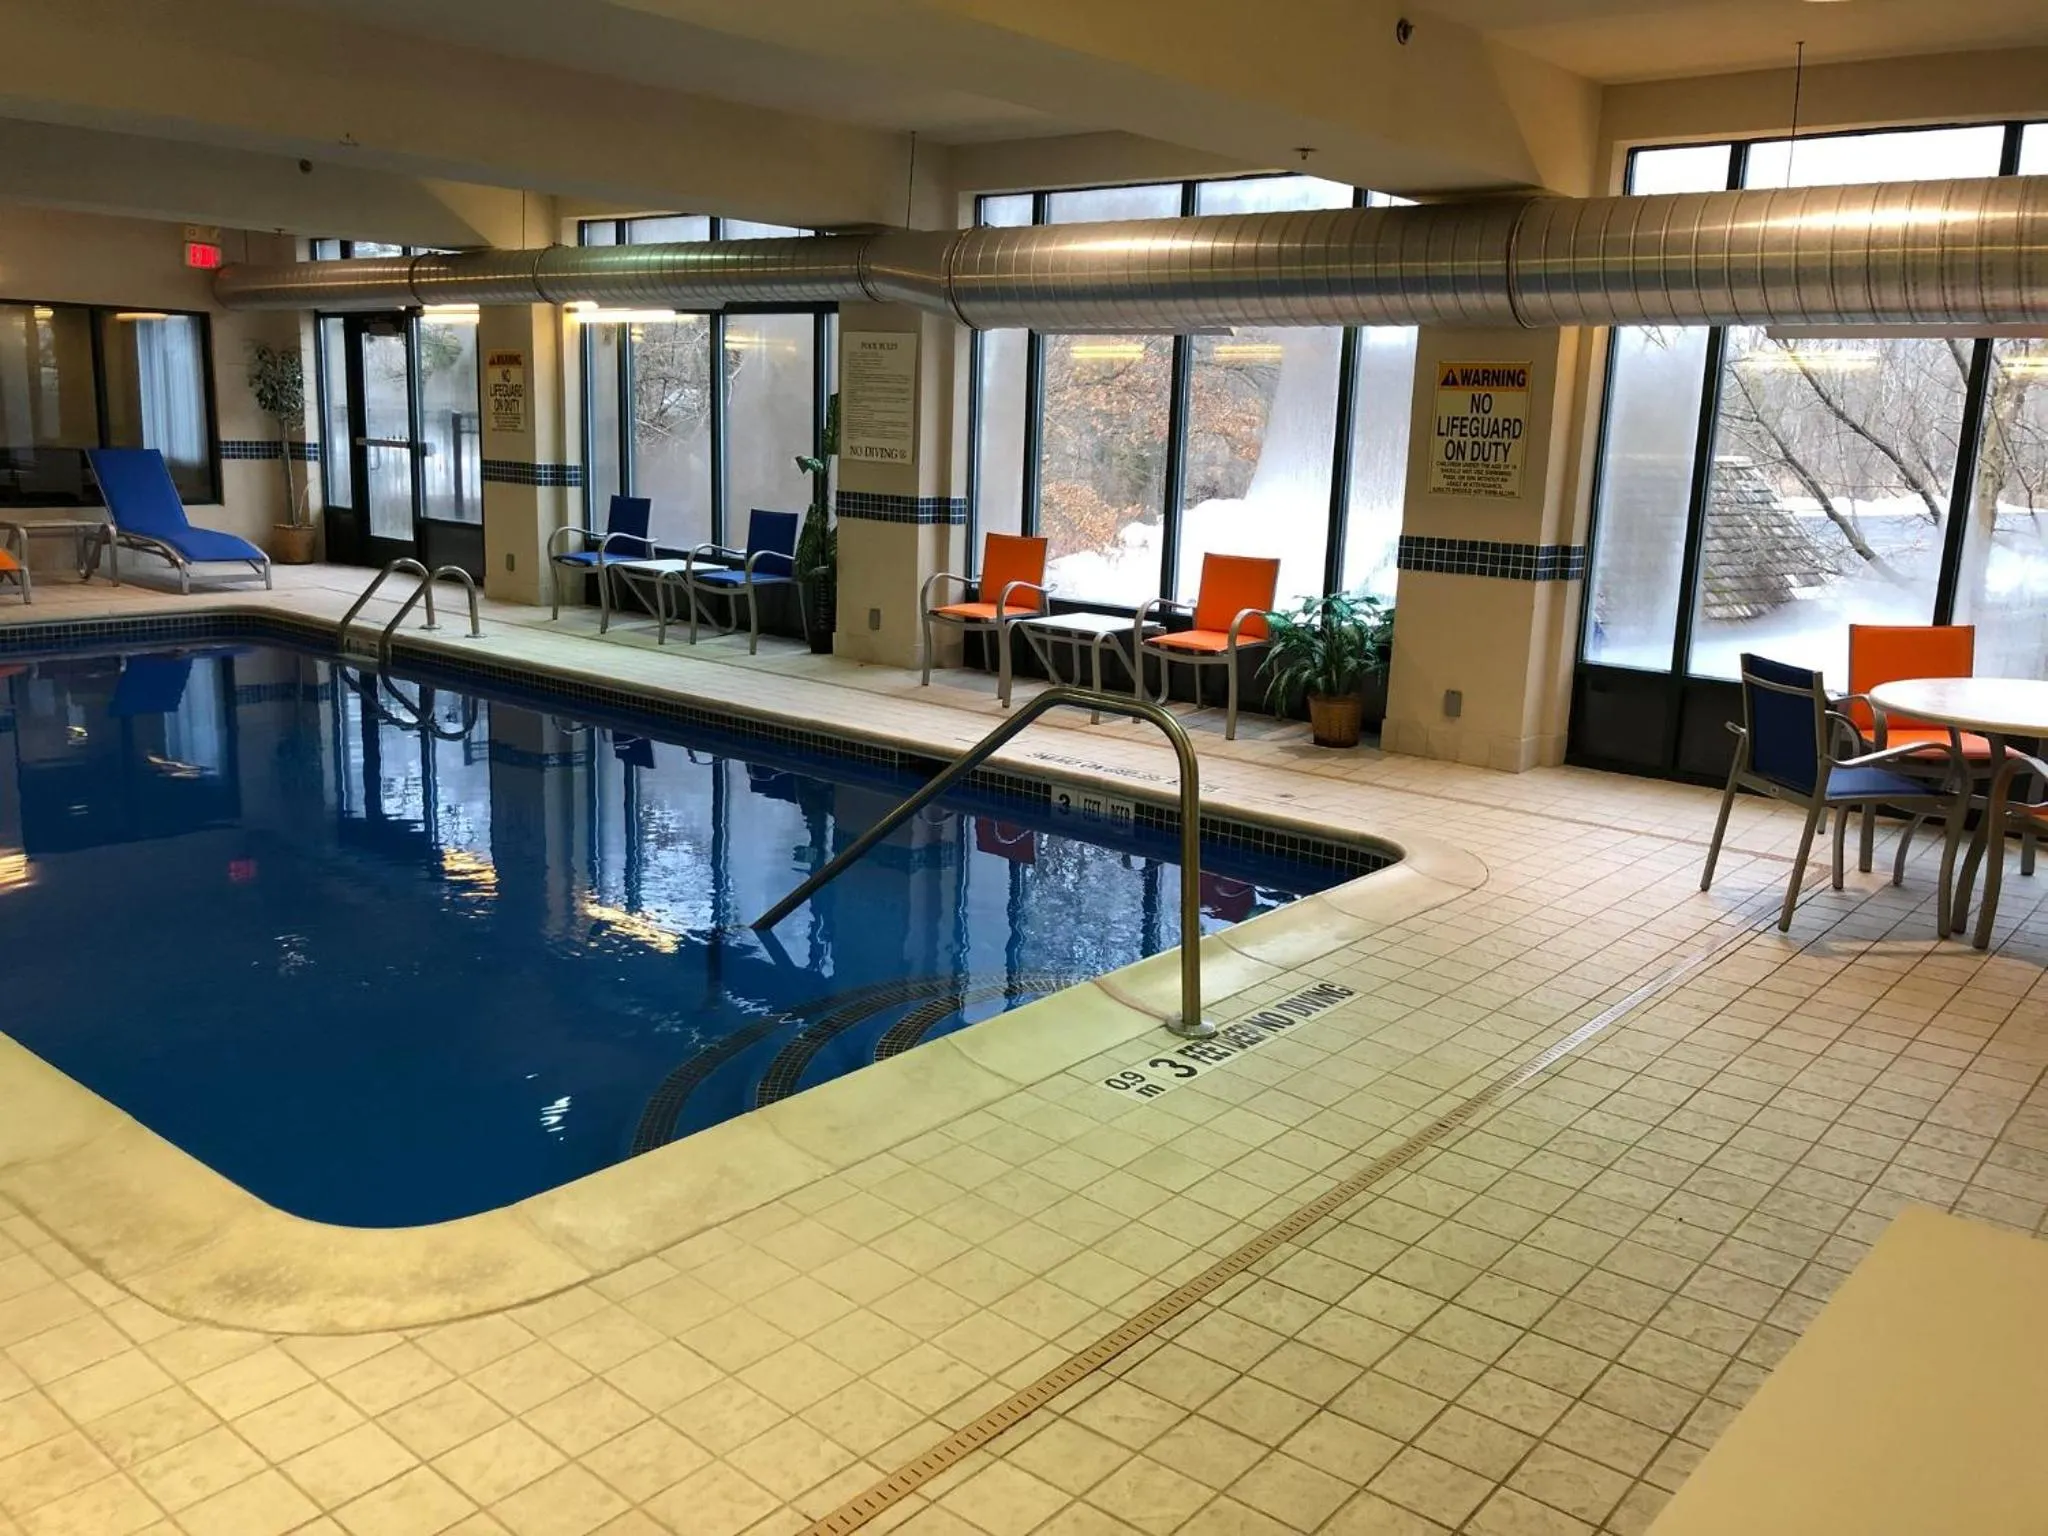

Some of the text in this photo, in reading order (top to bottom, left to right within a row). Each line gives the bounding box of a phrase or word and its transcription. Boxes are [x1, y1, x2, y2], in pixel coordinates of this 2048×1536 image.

[1459, 368, 1527, 388] WARNING
[1470, 393, 1493, 415] NO
[1437, 415, 1523, 439] LIFEGUARD
[850, 445, 898, 460] NO DIVING
[1444, 439, 1512, 463] ON DUTY
[1275, 983, 1355, 1018] DIVING
[1244, 1010, 1297, 1033] NO
[1221, 1024, 1269, 1050] DEEP
[1176, 1039, 1238, 1066] FEET
[1149, 1058, 1198, 1079] 3
[1135, 1083, 1166, 1098] m
